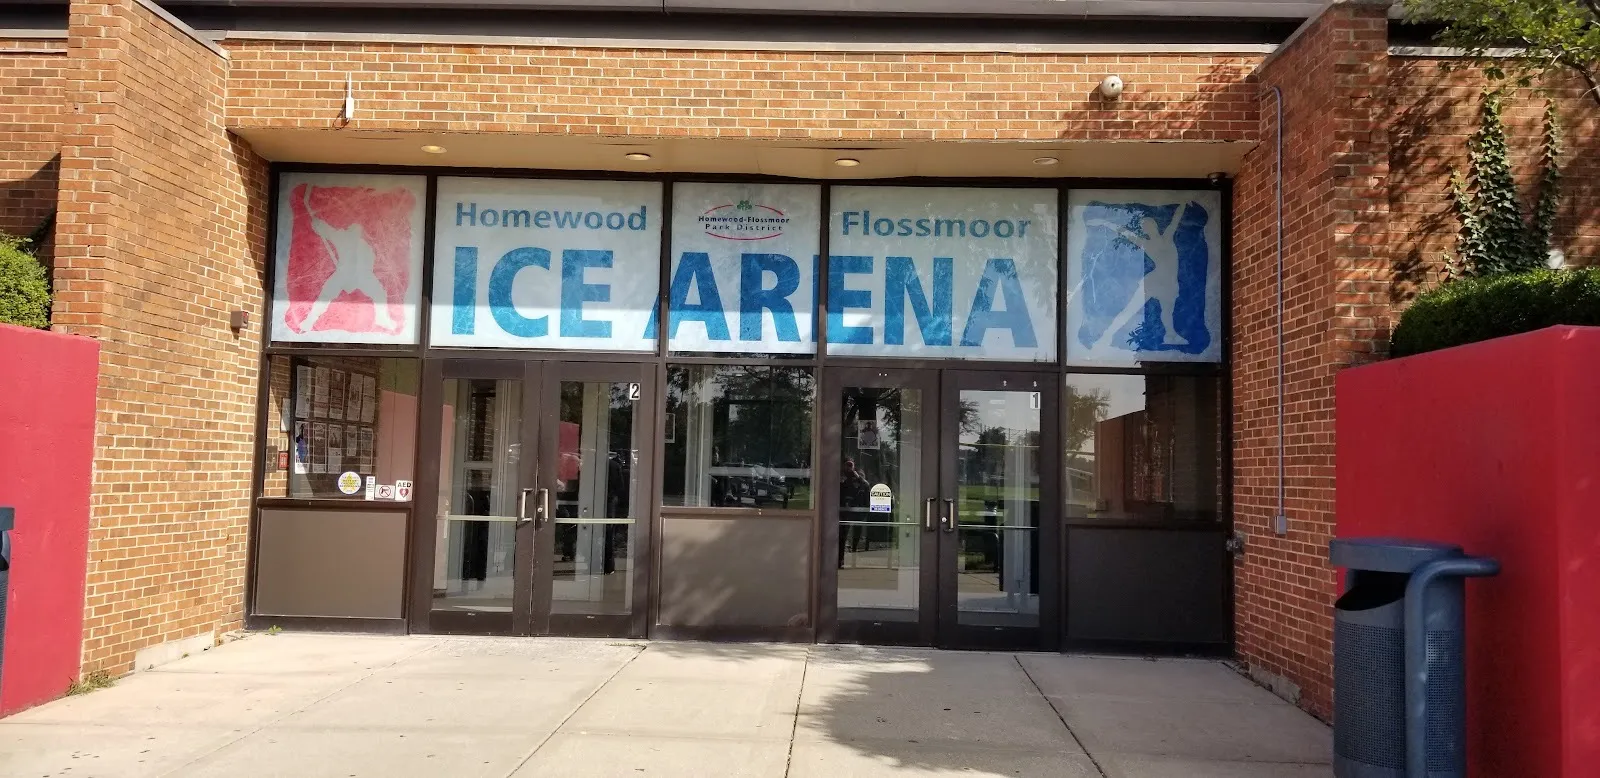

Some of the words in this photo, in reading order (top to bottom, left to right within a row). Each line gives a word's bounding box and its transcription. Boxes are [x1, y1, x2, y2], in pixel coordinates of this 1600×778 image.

[455, 201, 648, 231] Homewood
[698, 215, 790, 224] Homewood-Flossmoor
[842, 209, 1032, 238] Flossmoor
[736, 223, 783, 231] District
[451, 246, 614, 339] ICE
[642, 251, 1039, 349] ARENA
[631, 383, 640, 399] 2
[1032, 392, 1039, 408] 1
